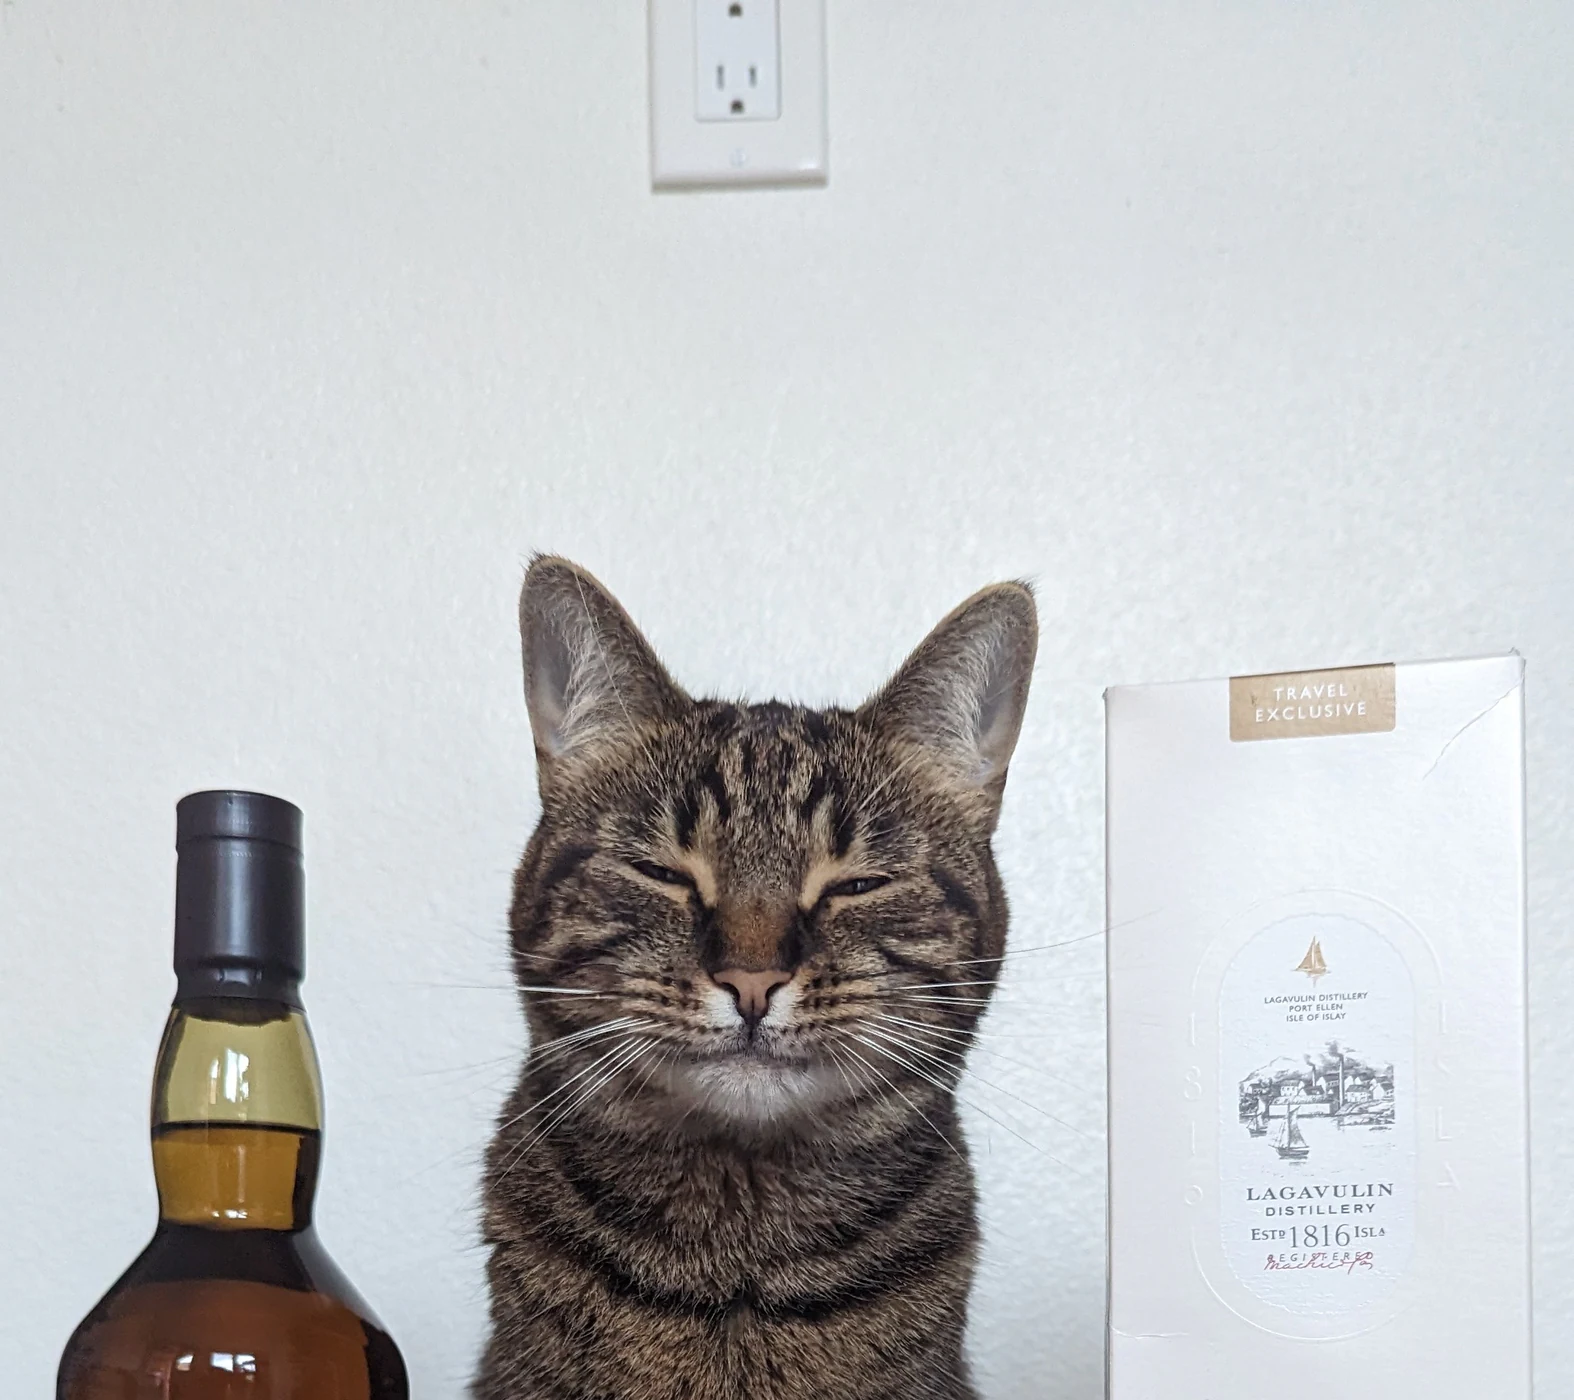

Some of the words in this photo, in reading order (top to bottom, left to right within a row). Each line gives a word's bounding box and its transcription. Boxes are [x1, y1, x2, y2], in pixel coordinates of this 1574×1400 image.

[1274, 684, 1348, 701] TRAVEL
[1255, 702, 1366, 722] EXCLUSIVE
[1264, 994, 1316, 1004] LAGAVULIN
[1318, 992, 1369, 1002] DISTILLERY
[1288, 1004, 1313, 1013] PORT
[1316, 1003, 1343, 1012] ELLEN
[1286, 1014, 1304, 1022] ISLE
[1306, 1013, 1320, 1022] OF
[1321, 1012, 1346, 1021] ISLAY
[1246, 1182, 1394, 1202] LAGAVULIN
[1265, 1203, 1376, 1217] DISTILLERY
[1288, 1223, 1351, 1248] 1816
